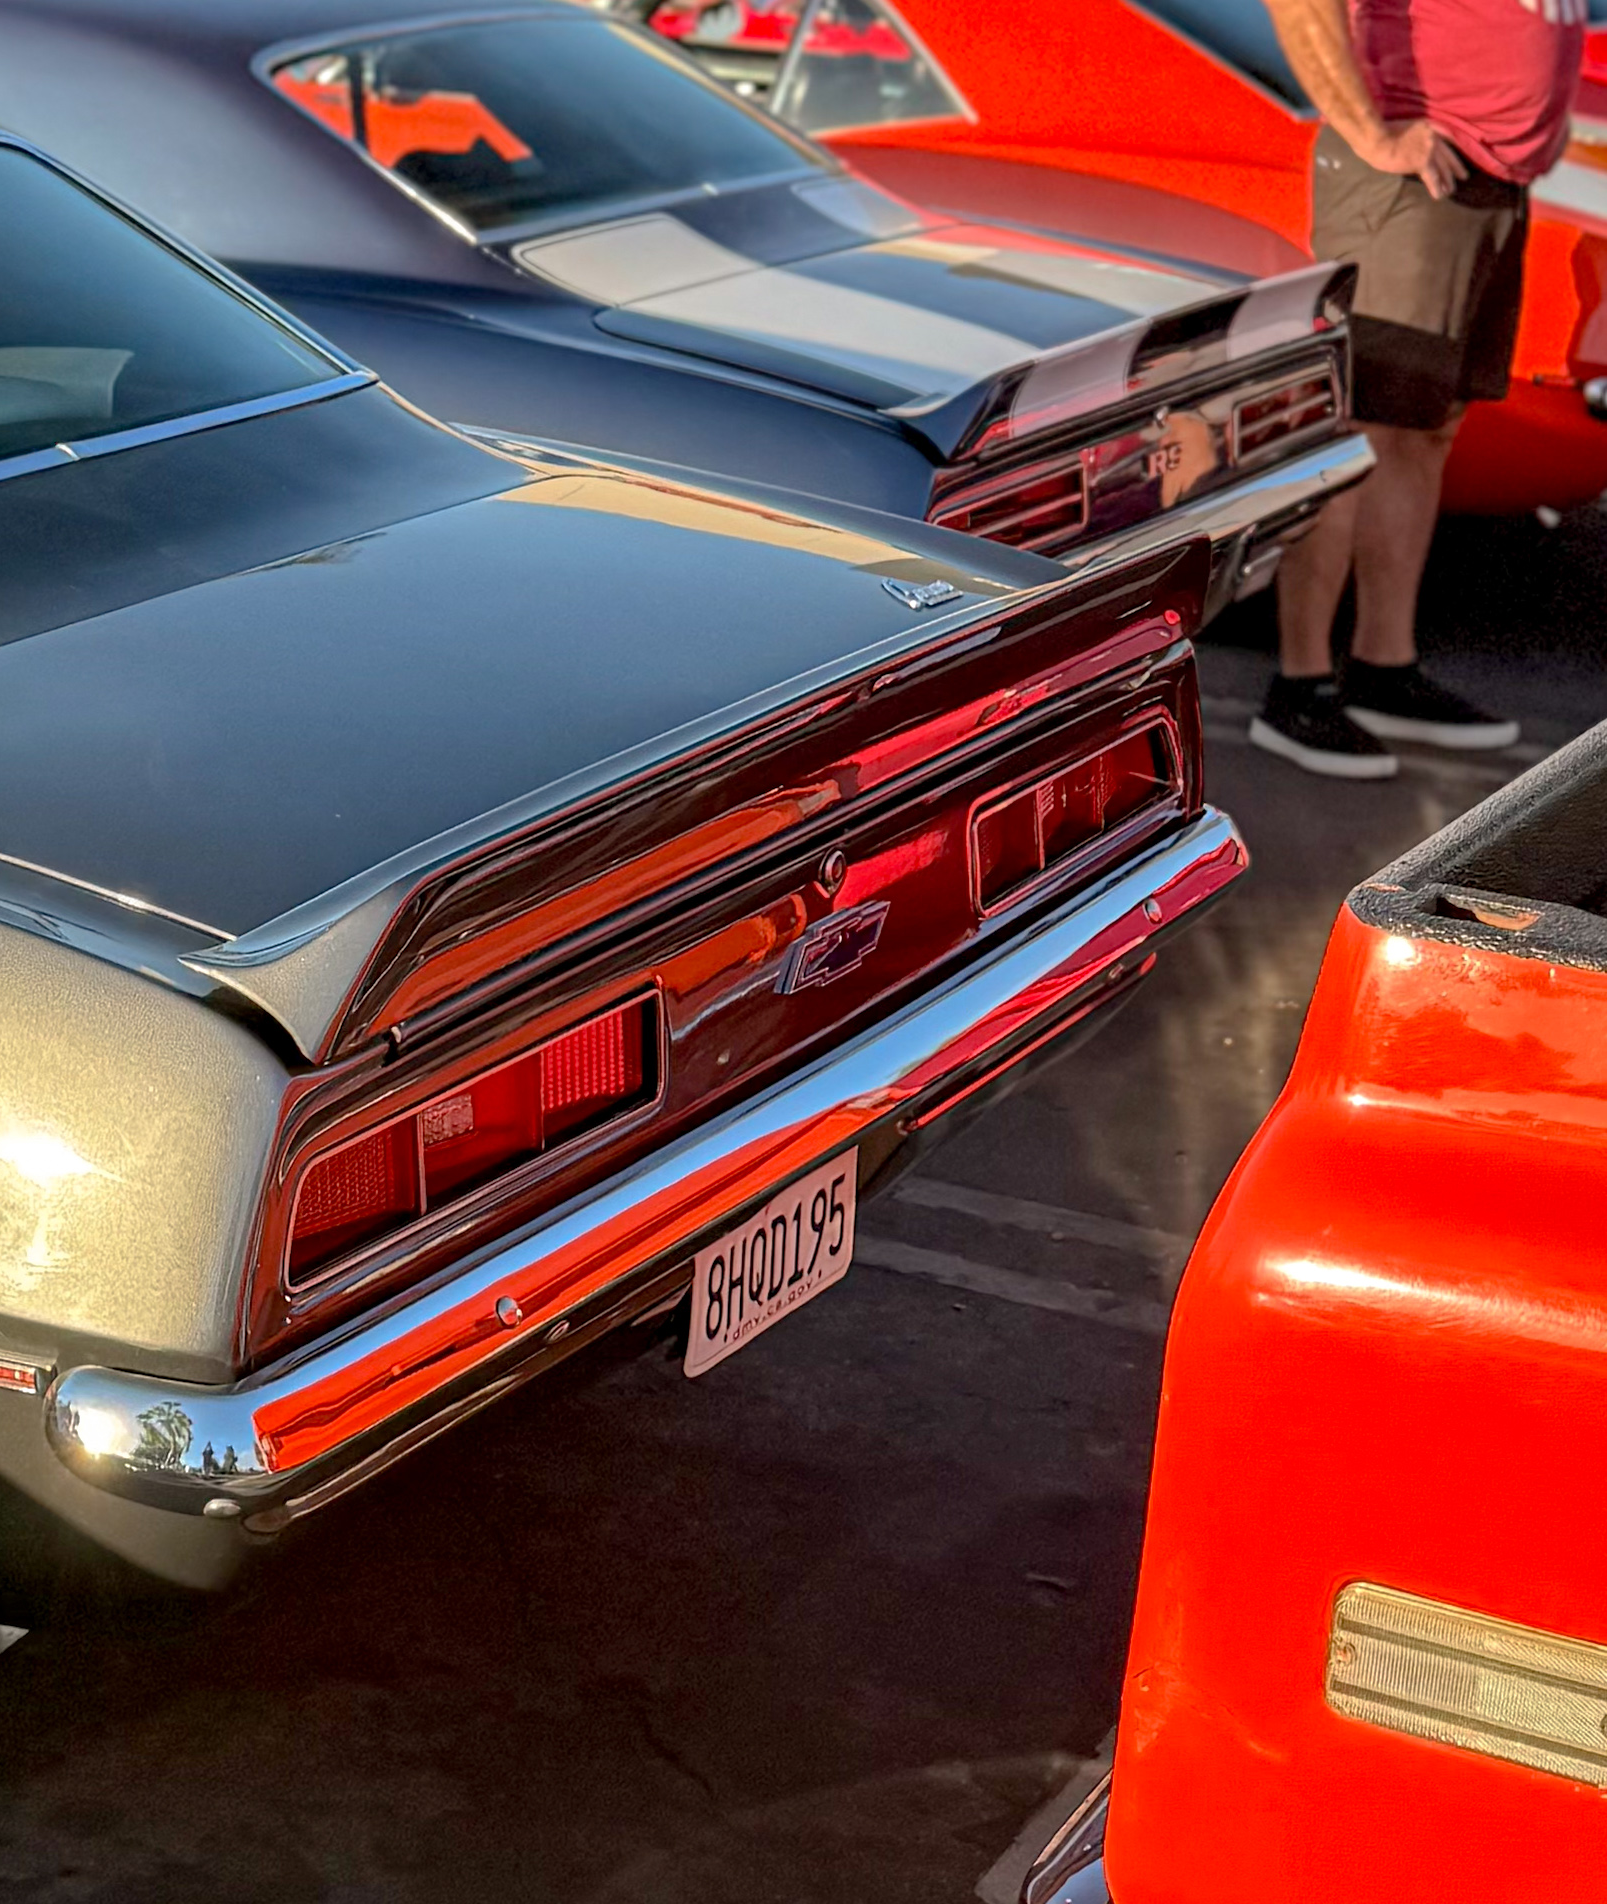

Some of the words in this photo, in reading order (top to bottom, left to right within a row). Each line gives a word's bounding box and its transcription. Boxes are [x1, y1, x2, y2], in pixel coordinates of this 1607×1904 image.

[1147, 444, 1182, 480] RS
[705, 1173, 847, 1341] 8HQD195
[732, 1280, 814, 1341] dmv.ca.gov
